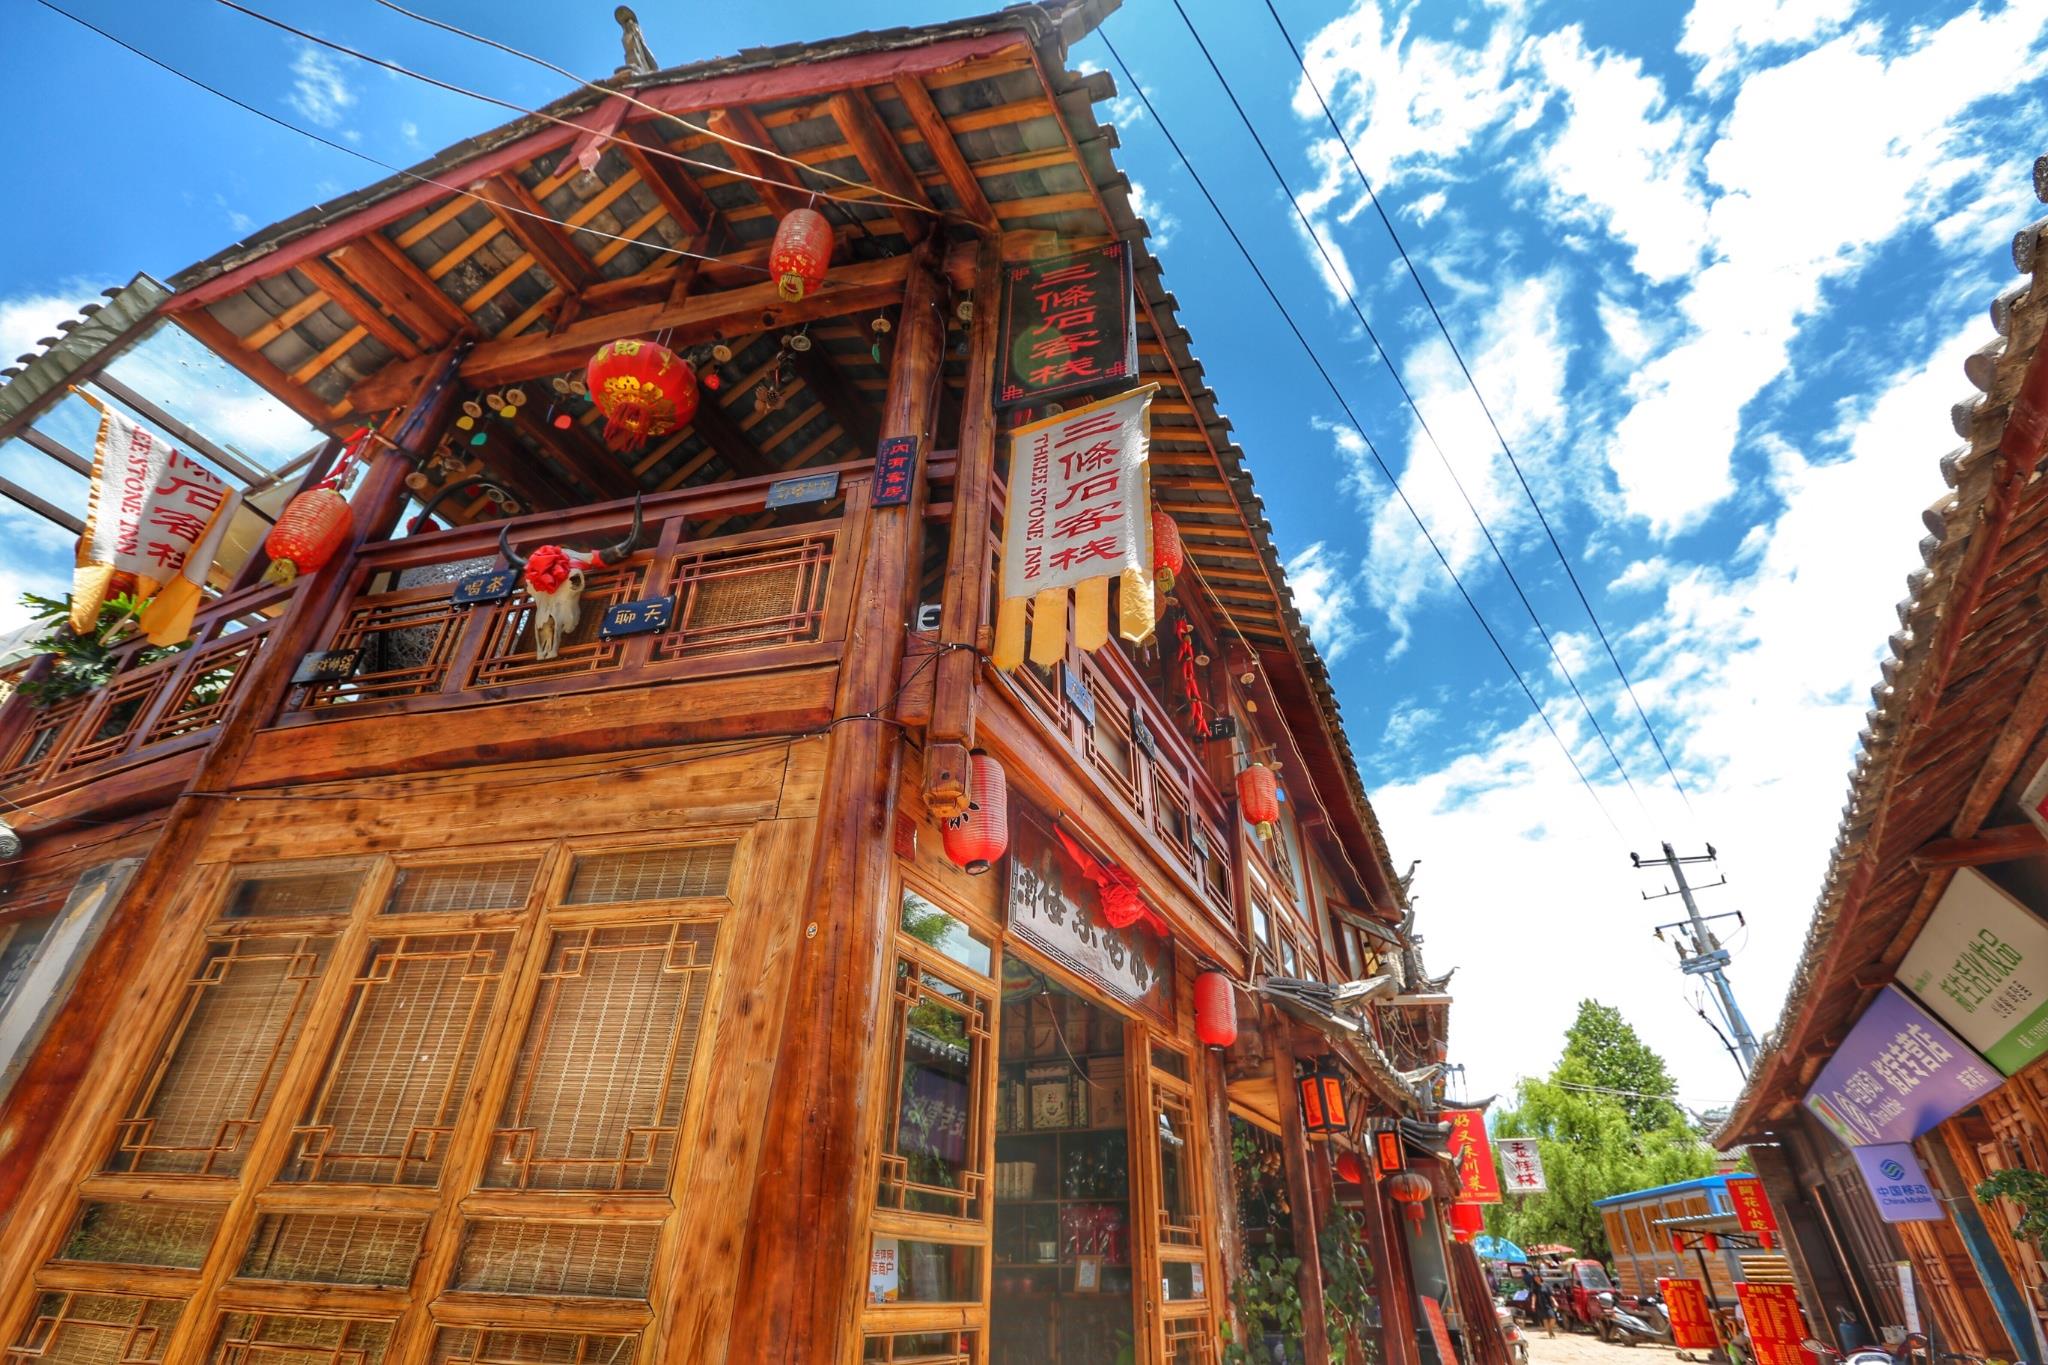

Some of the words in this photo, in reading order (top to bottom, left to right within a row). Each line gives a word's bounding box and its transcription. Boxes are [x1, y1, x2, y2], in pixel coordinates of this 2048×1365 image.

[1031, 433, 1049, 486] THREE
[119, 454, 147, 517] STONE
[1049, 411, 1125, 572] 三條石客栈
[1026, 485, 1047, 542] STONE
[117, 519, 140, 556] INN
[1024, 543, 1044, 580] INN
[464, 575, 506, 597] 喝茶
[615, 603, 663, 625] 聊天
[1939, 928, 2023, 1014] 新生活化妆品
[1876, 1184, 1929, 1198] 中国移动
